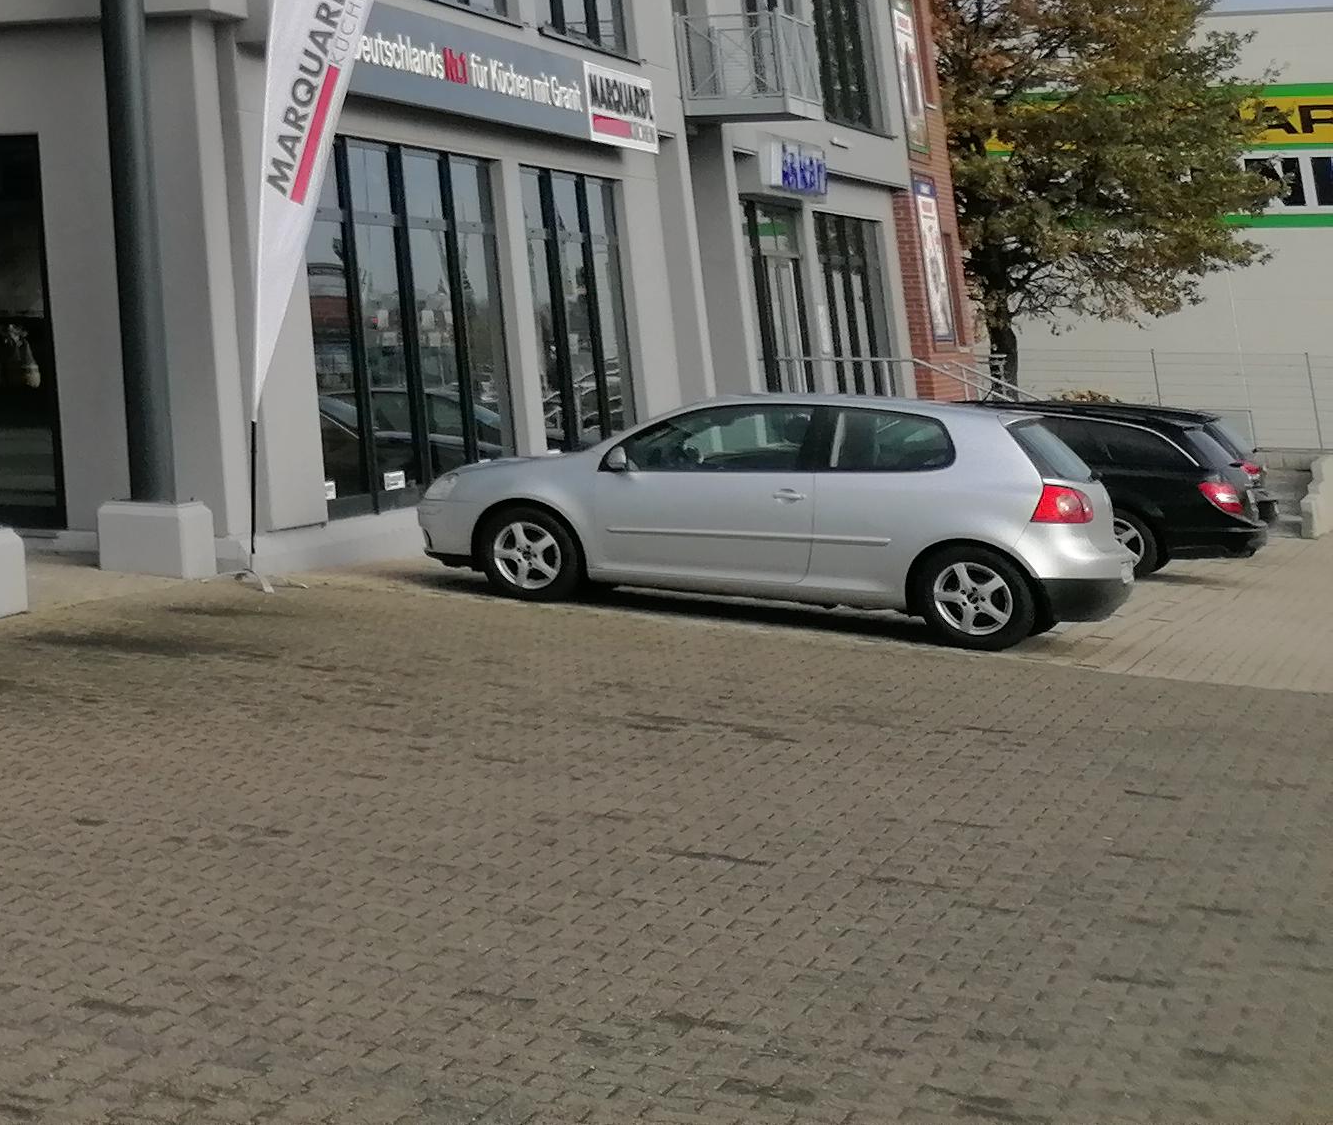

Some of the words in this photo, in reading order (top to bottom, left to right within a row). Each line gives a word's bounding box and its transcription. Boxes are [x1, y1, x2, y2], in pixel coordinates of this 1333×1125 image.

[469, 53, 490, 90] für
[489, 57, 533, 101] Küchen
[532, 73, 551, 106] mit
[549, 77, 584, 113] Granit
